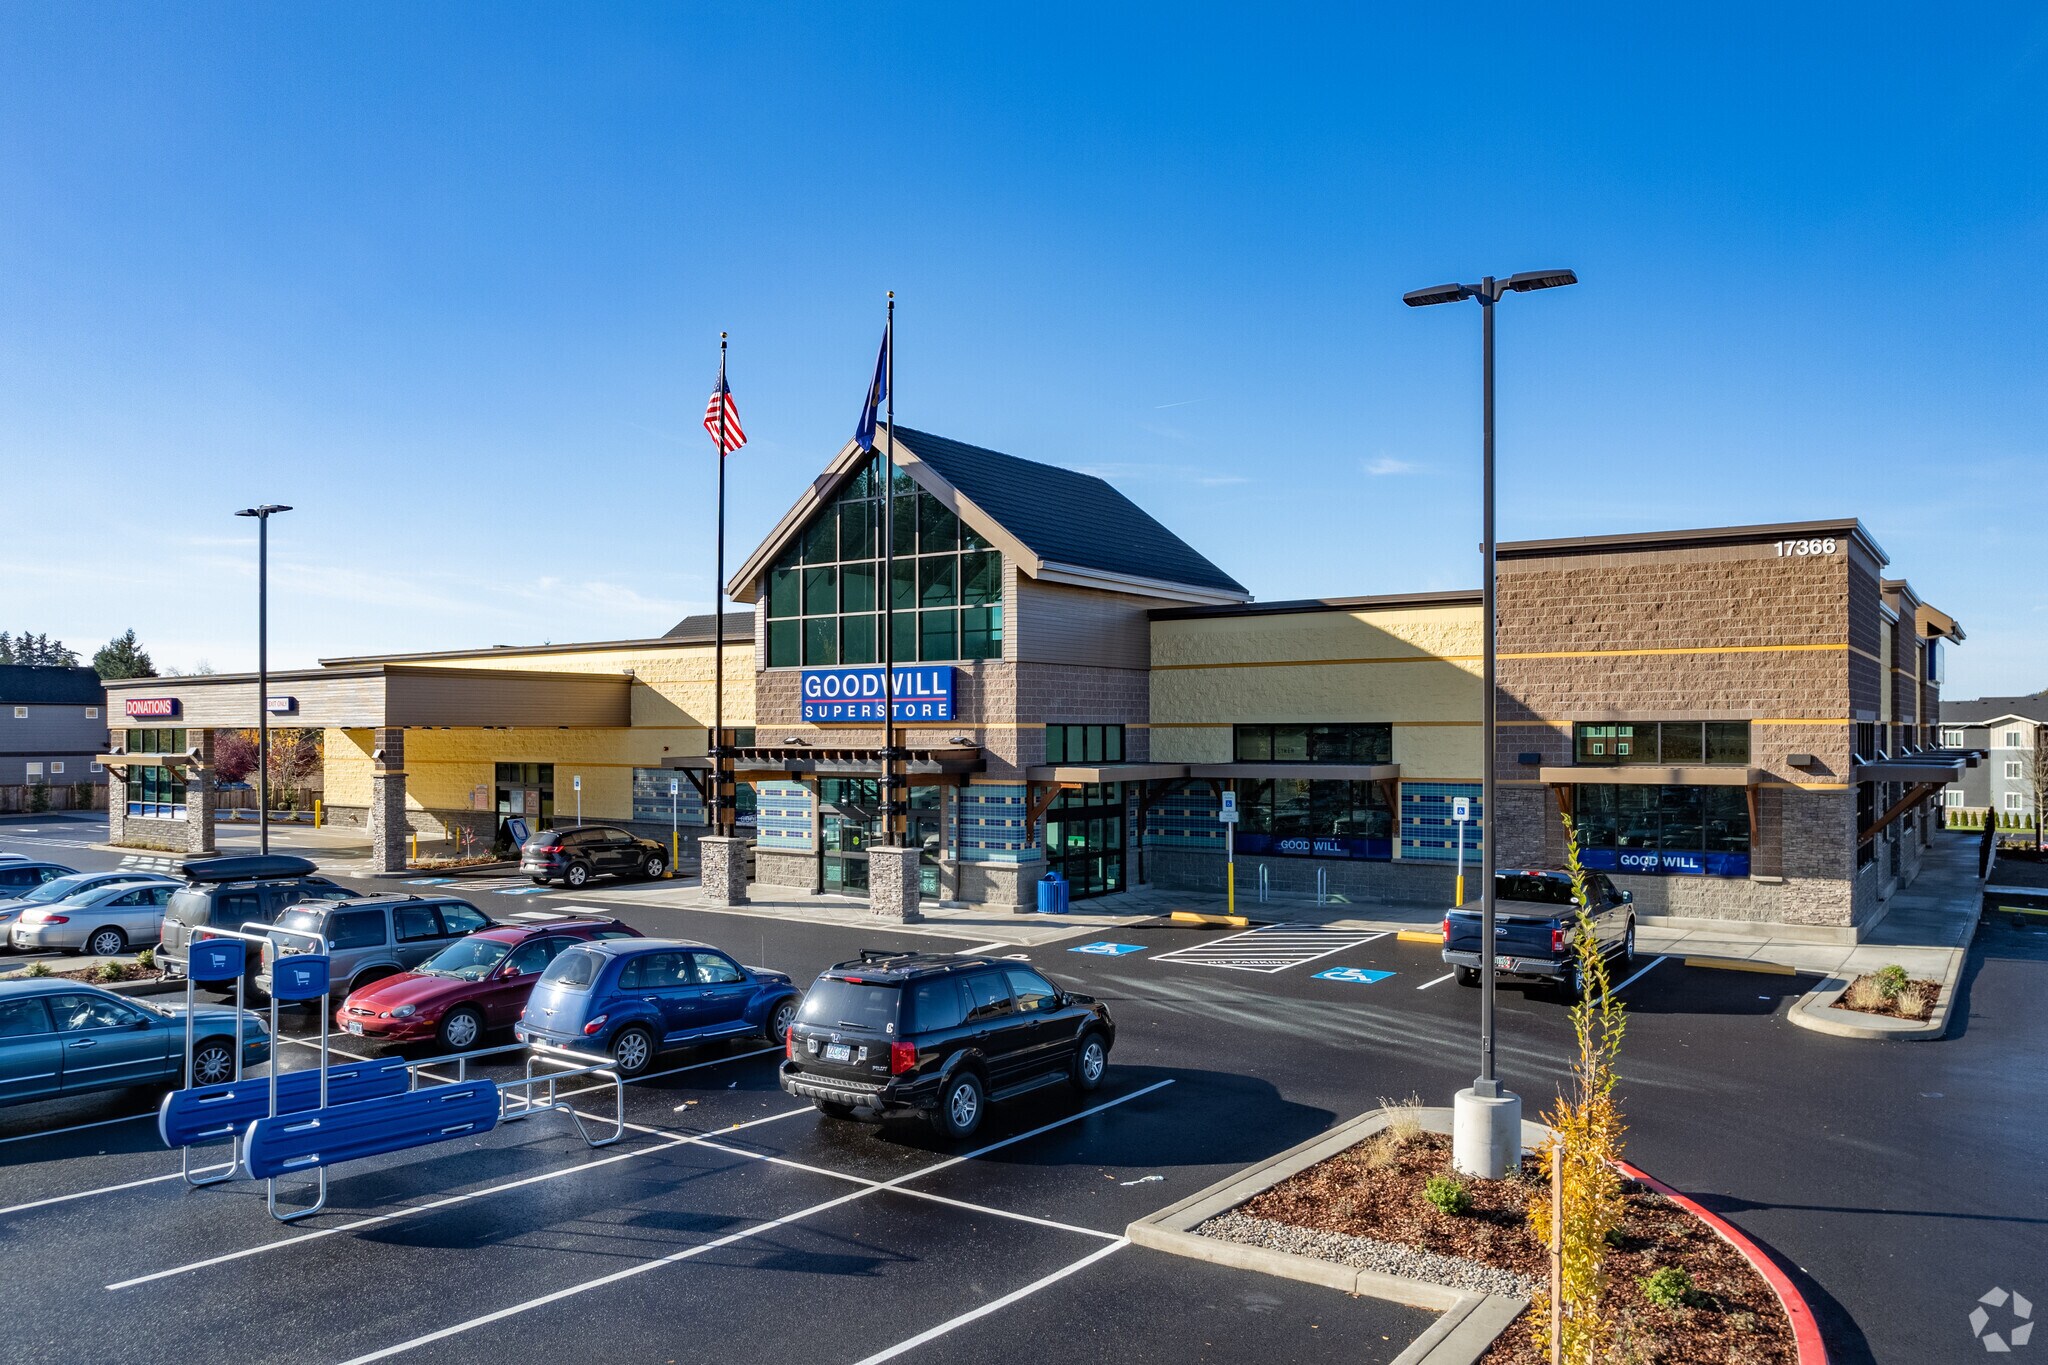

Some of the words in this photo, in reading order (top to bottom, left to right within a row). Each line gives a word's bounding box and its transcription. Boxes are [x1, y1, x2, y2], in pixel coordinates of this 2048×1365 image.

[1774, 537, 1837, 557] 17366
[805, 671, 947, 698] GOODWILL
[126, 700, 171, 714] DONATIONS
[805, 703, 947, 718] SUPERSTORE
[1280, 840, 1311, 851] GOOD
[1313, 841, 1342, 852] WILL
[1620, 854, 1659, 867] GOOD
[1662, 856, 1699, 869] WILL
